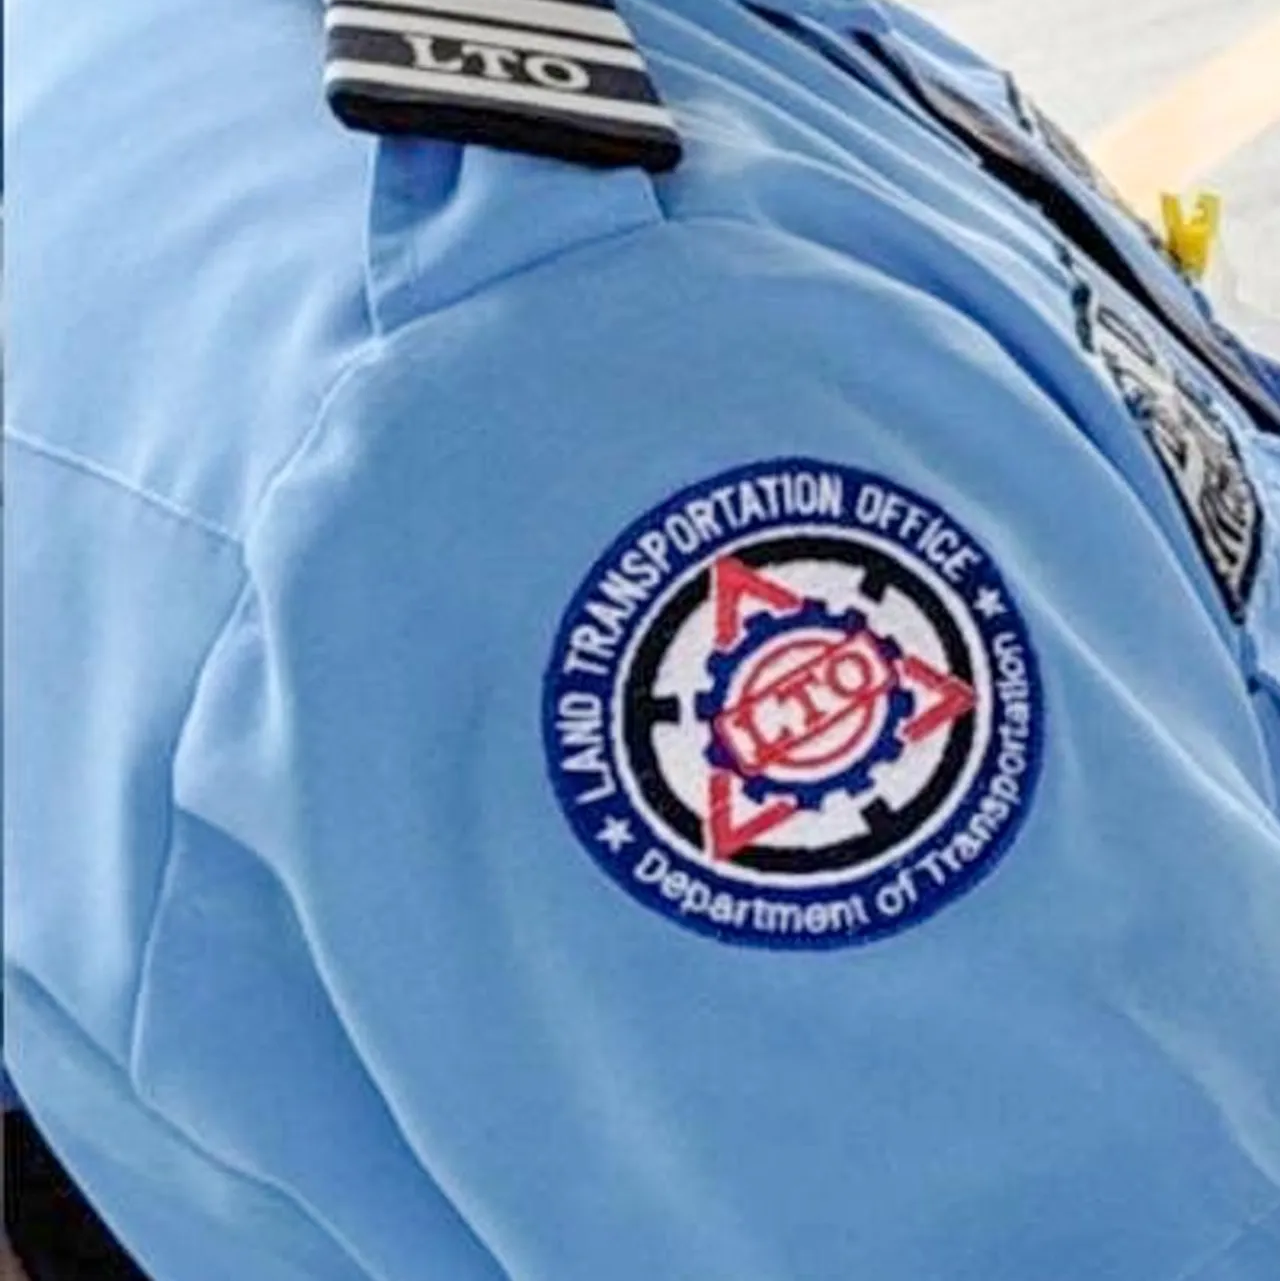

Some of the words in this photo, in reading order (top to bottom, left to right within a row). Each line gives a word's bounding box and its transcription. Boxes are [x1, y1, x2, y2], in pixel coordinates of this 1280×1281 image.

[404, 33, 591, 92] LTO
[564, 472, 842, 683] TRANSPORTATION
[856, 486, 983, 583] OFFICE
[556, 694, 616, 803] LAND
[729, 647, 876, 755] LTO
[634, 848, 867, 935] Department
[875, 876, 921, 919] of
[914, 630, 1032, 883] Transportation
